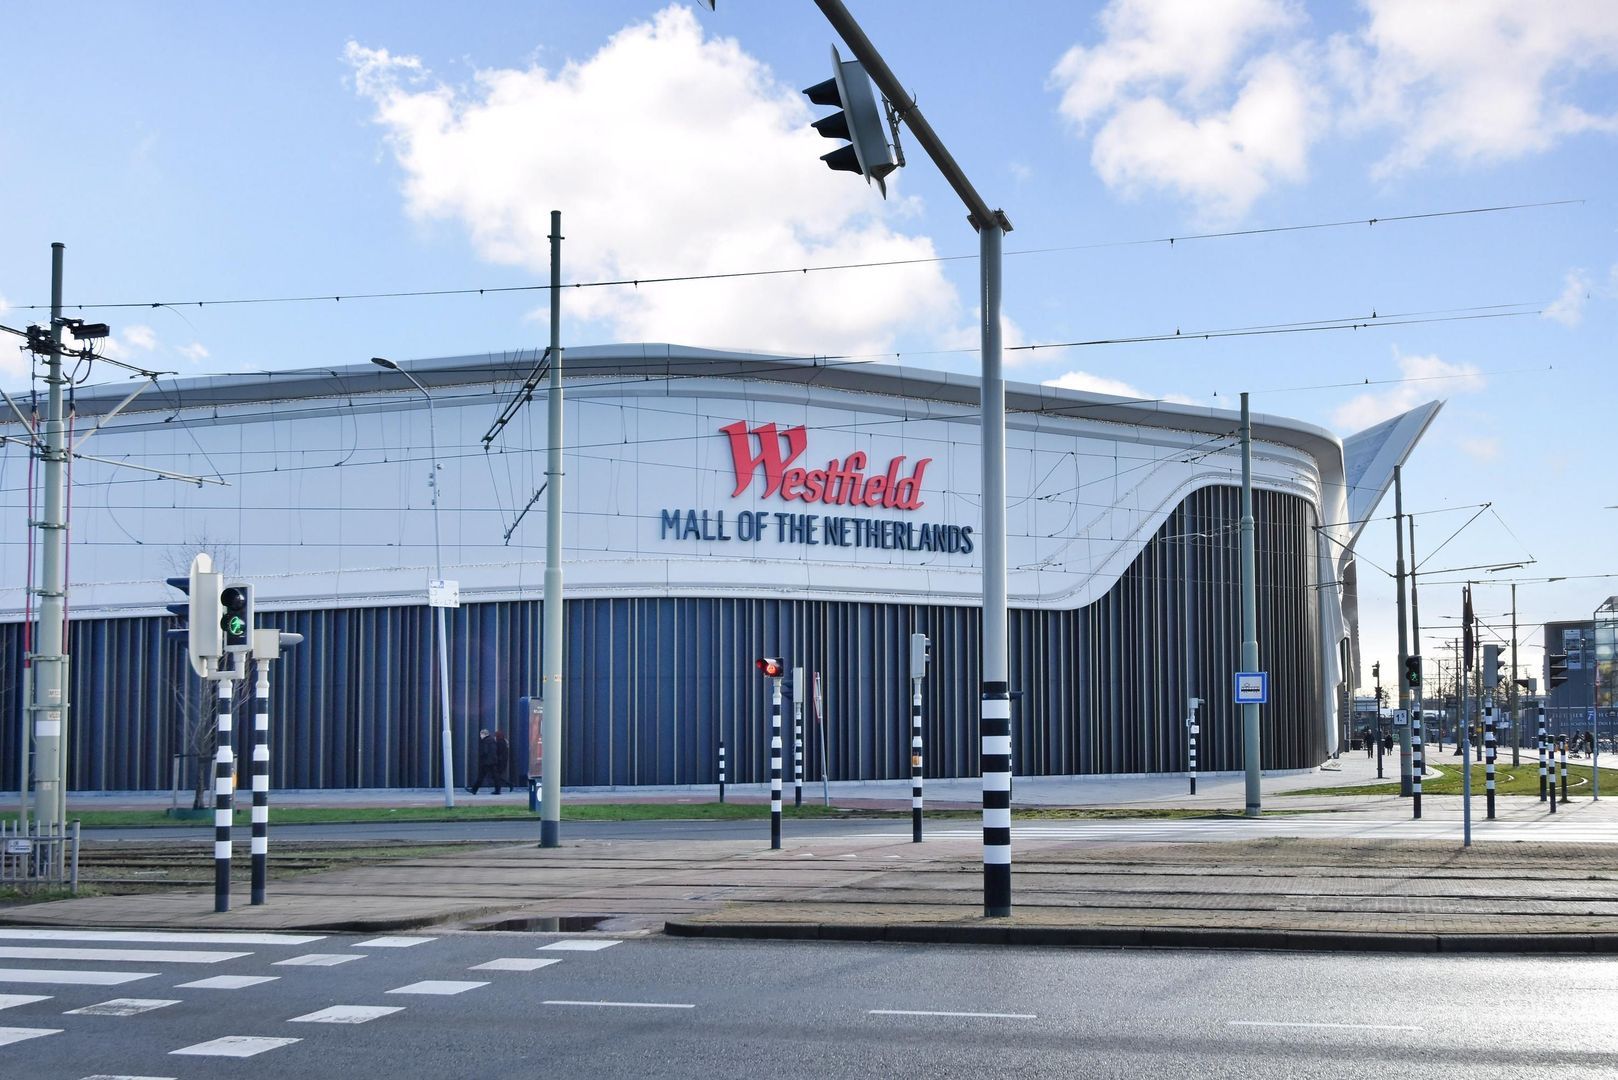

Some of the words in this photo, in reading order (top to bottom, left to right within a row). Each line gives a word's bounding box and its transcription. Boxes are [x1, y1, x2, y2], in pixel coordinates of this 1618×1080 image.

[718, 419, 932, 511] Westfield
[661, 508, 731, 541] MALL
[738, 510, 769, 542] OF
[774, 512, 819, 545] THE
[824, 515, 974, 554] NETHERLANDS
